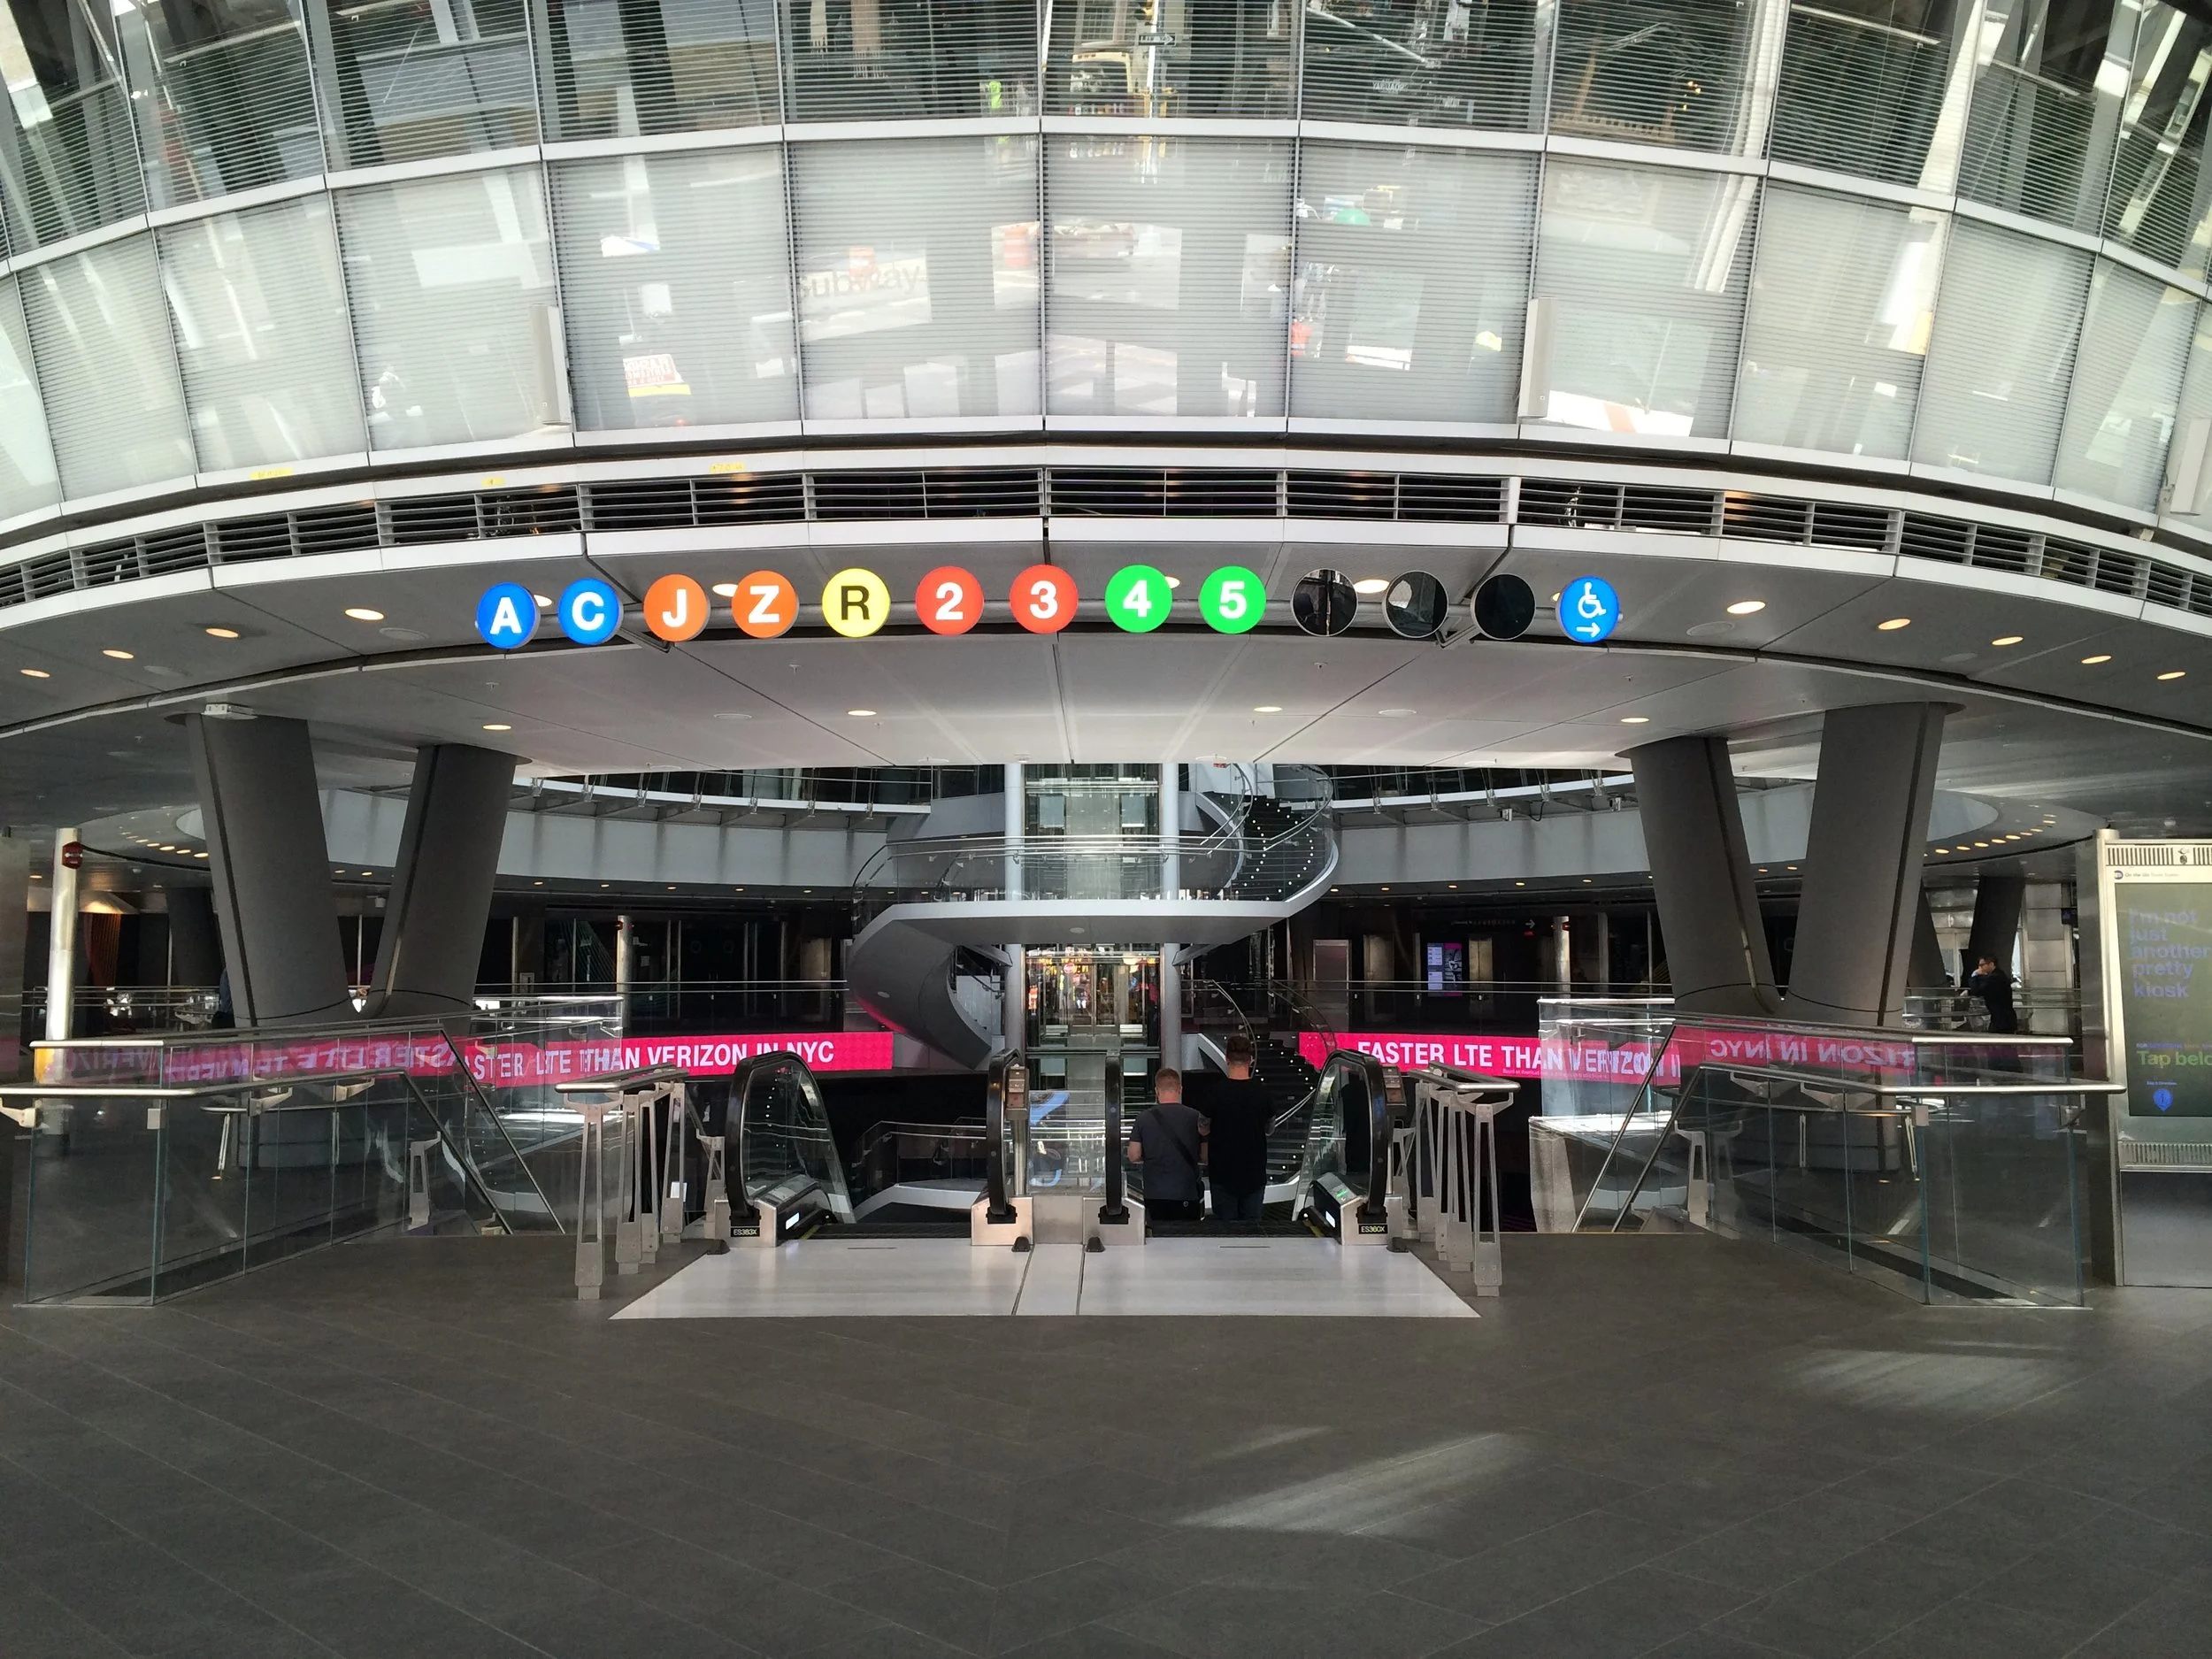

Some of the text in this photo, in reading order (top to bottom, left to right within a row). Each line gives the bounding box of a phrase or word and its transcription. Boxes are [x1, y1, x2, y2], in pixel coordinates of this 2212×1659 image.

[489, 580, 1247, 634] A C J Z R 2 3 4 5
[2164, 909, 2198, 924] not
[2129, 925, 2168, 946] just
[2131, 943, 2211, 958] another
[2132, 960, 2194, 980] pretty
[2134, 981, 2189, 998] kiosk
[648, 1043, 747, 1068] VERIZON
[787, 1041, 834, 1064] NYC
[1454, 1043, 1493, 1067] LTE
[1501, 1045, 1563, 1070] THAN
[2136, 1050, 2171, 1069] Tap
